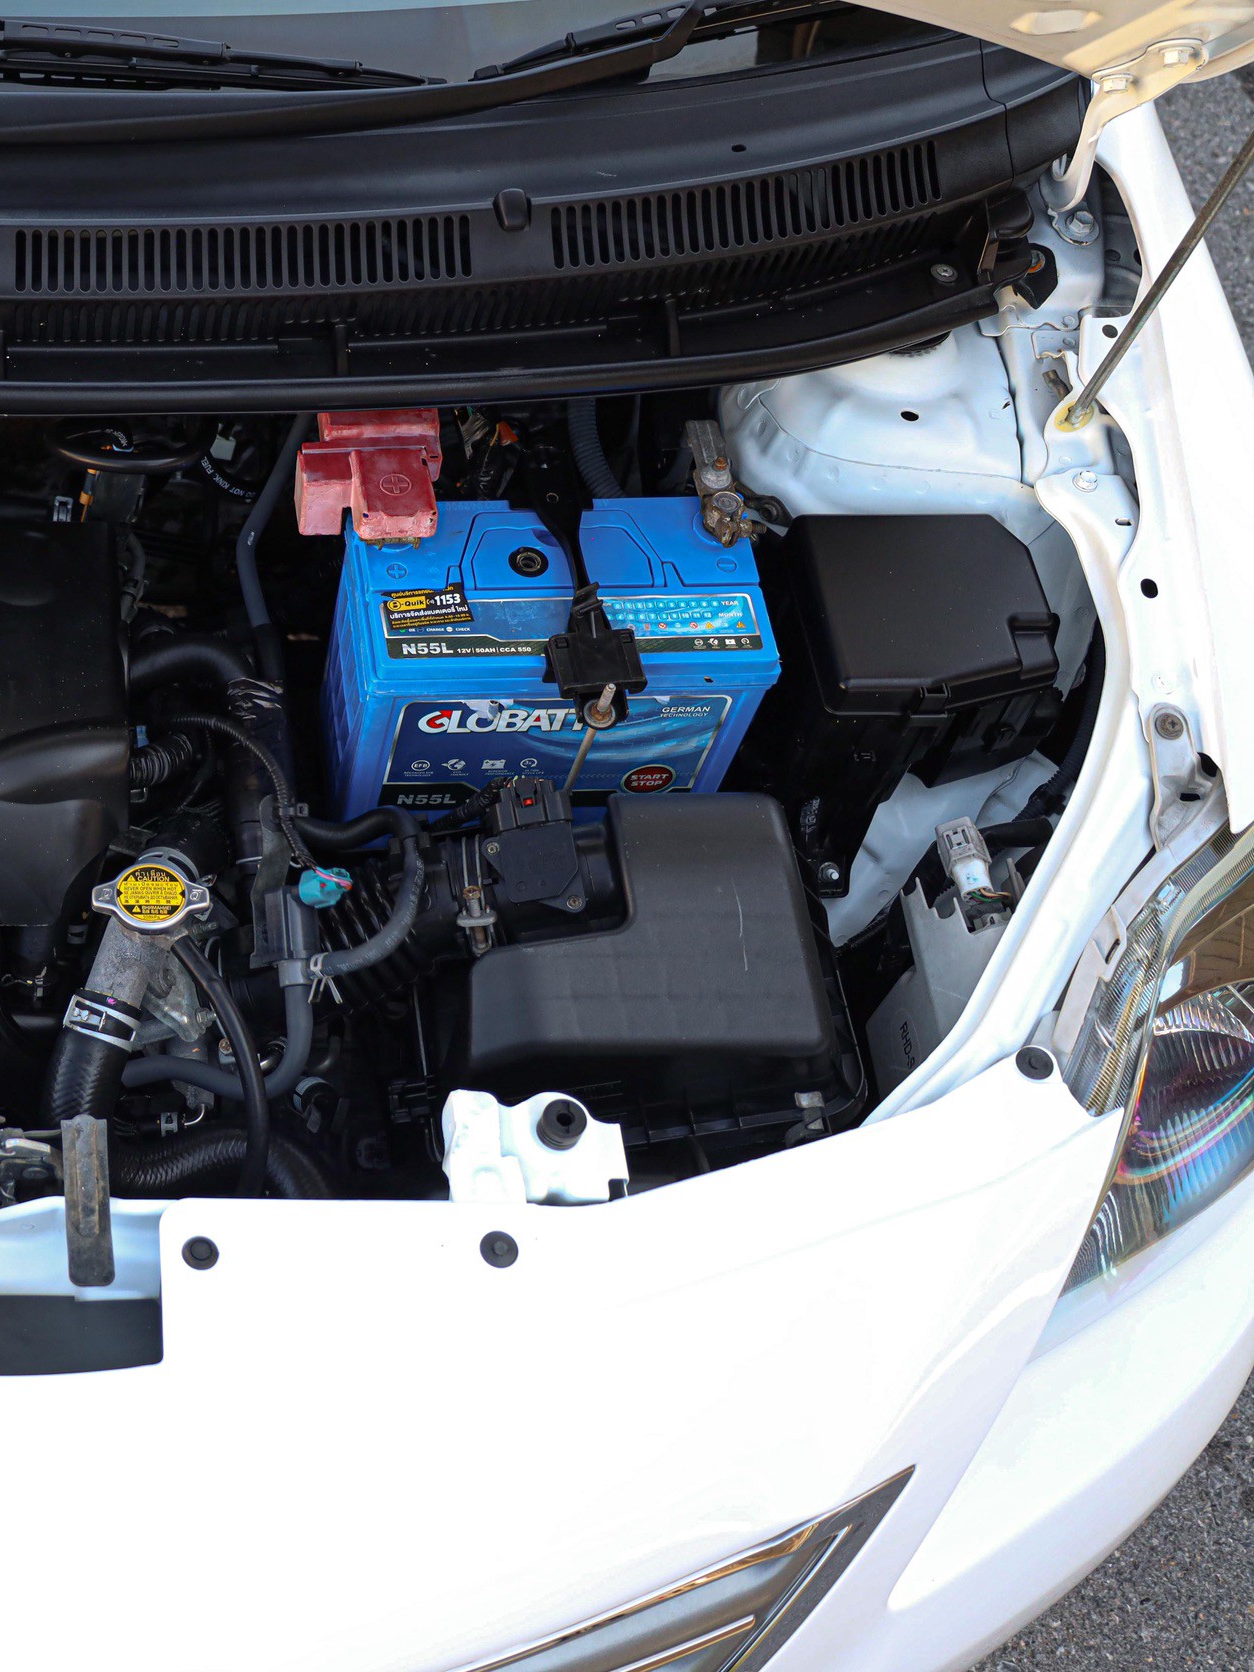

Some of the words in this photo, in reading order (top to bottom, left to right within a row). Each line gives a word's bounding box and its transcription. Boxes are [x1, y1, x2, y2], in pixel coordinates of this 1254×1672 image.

[200, 456, 214, 475] FUEL
[229, 486, 245, 496] NOT
[434, 594, 461, 606] 1153
[401, 642, 454, 655] N55L
[396, 794, 457, 805] N55L
